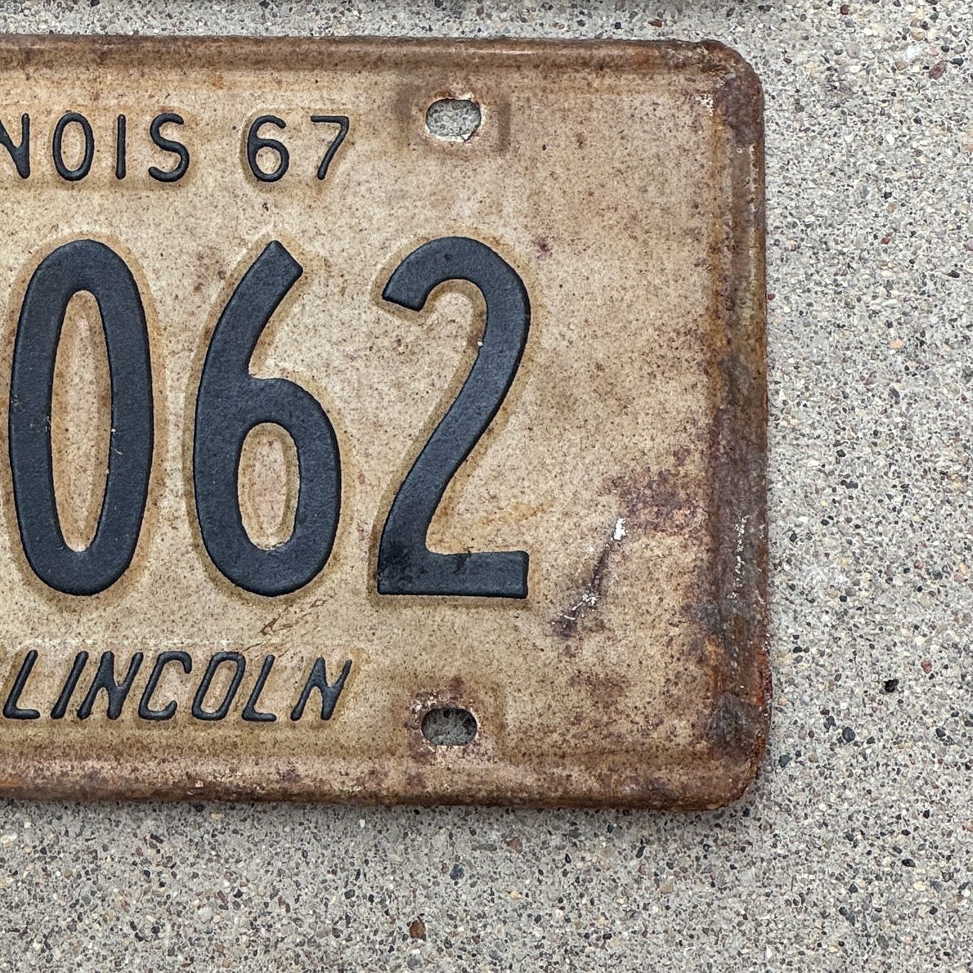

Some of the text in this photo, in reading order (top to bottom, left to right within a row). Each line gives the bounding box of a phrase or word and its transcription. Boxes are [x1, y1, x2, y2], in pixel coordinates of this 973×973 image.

[246, 115, 350, 182] 67
[8, 236, 530, 597] 062
[3, 650, 352, 721] LINCOLN
